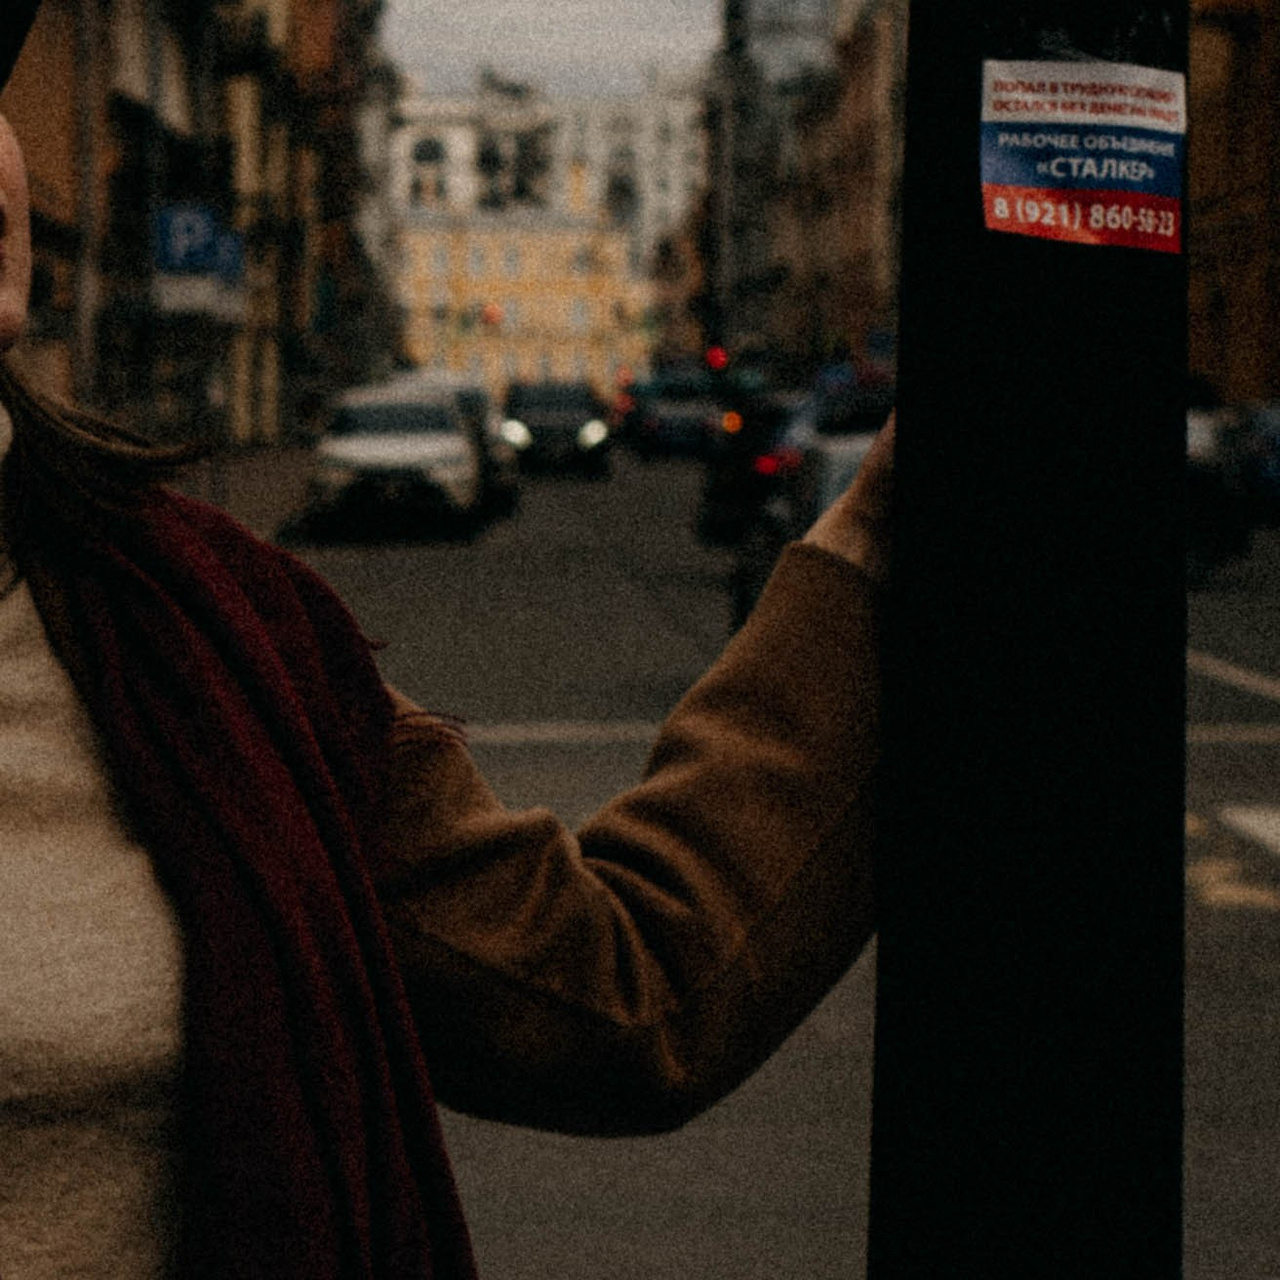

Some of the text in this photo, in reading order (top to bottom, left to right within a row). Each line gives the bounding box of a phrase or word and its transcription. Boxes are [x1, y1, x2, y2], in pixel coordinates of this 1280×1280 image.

[997, 132, 1080, 149] РАБОЧЕЕ
[1035, 157, 1156, 182] «СТАЛКЕР»
[993, 196, 1011, 220] 8
[1016, 196, 1082, 231] (921)
